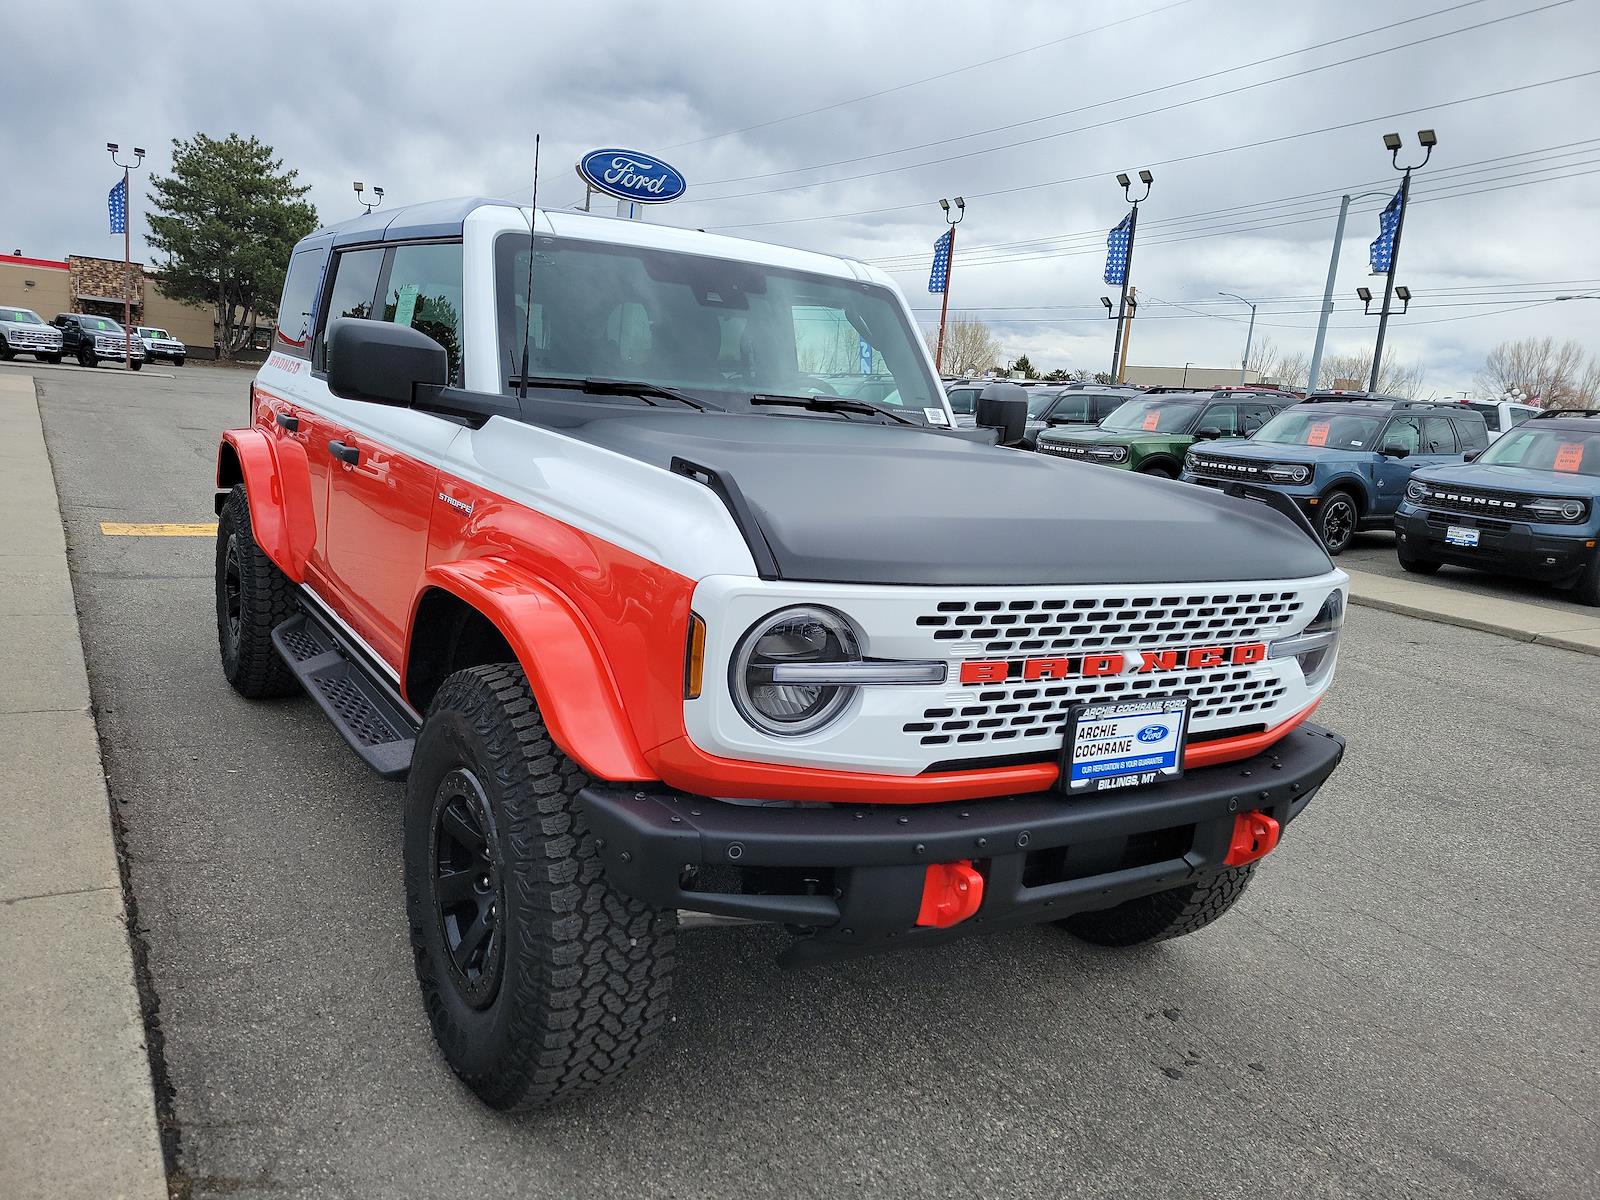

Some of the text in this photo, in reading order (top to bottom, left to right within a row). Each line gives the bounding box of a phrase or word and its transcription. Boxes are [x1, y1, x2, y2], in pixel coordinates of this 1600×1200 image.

[603, 156, 668, 194] Ford
[269, 355, 301, 375] BRONCO
[1043, 444, 1085, 454] BRONCO
[1200, 461, 1258, 473] BRONCO
[438, 492, 472, 514] STROPPE
[1434, 492, 1517, 508] BRONCO
[959, 643, 1266, 683] BRONCO
[1083, 699, 1187, 717] ARCHIE COCHRANE FORD
[1078, 724, 1118, 740] ARCHIE
[1142, 727, 1164, 741] Ford
[1075, 740, 1132, 758] COCHRANE
[1081, 756, 1164, 774] OUR REPUTATION IS YOUR GUARANTEE
[1097, 773, 1157, 790] BILLINGS, MT
